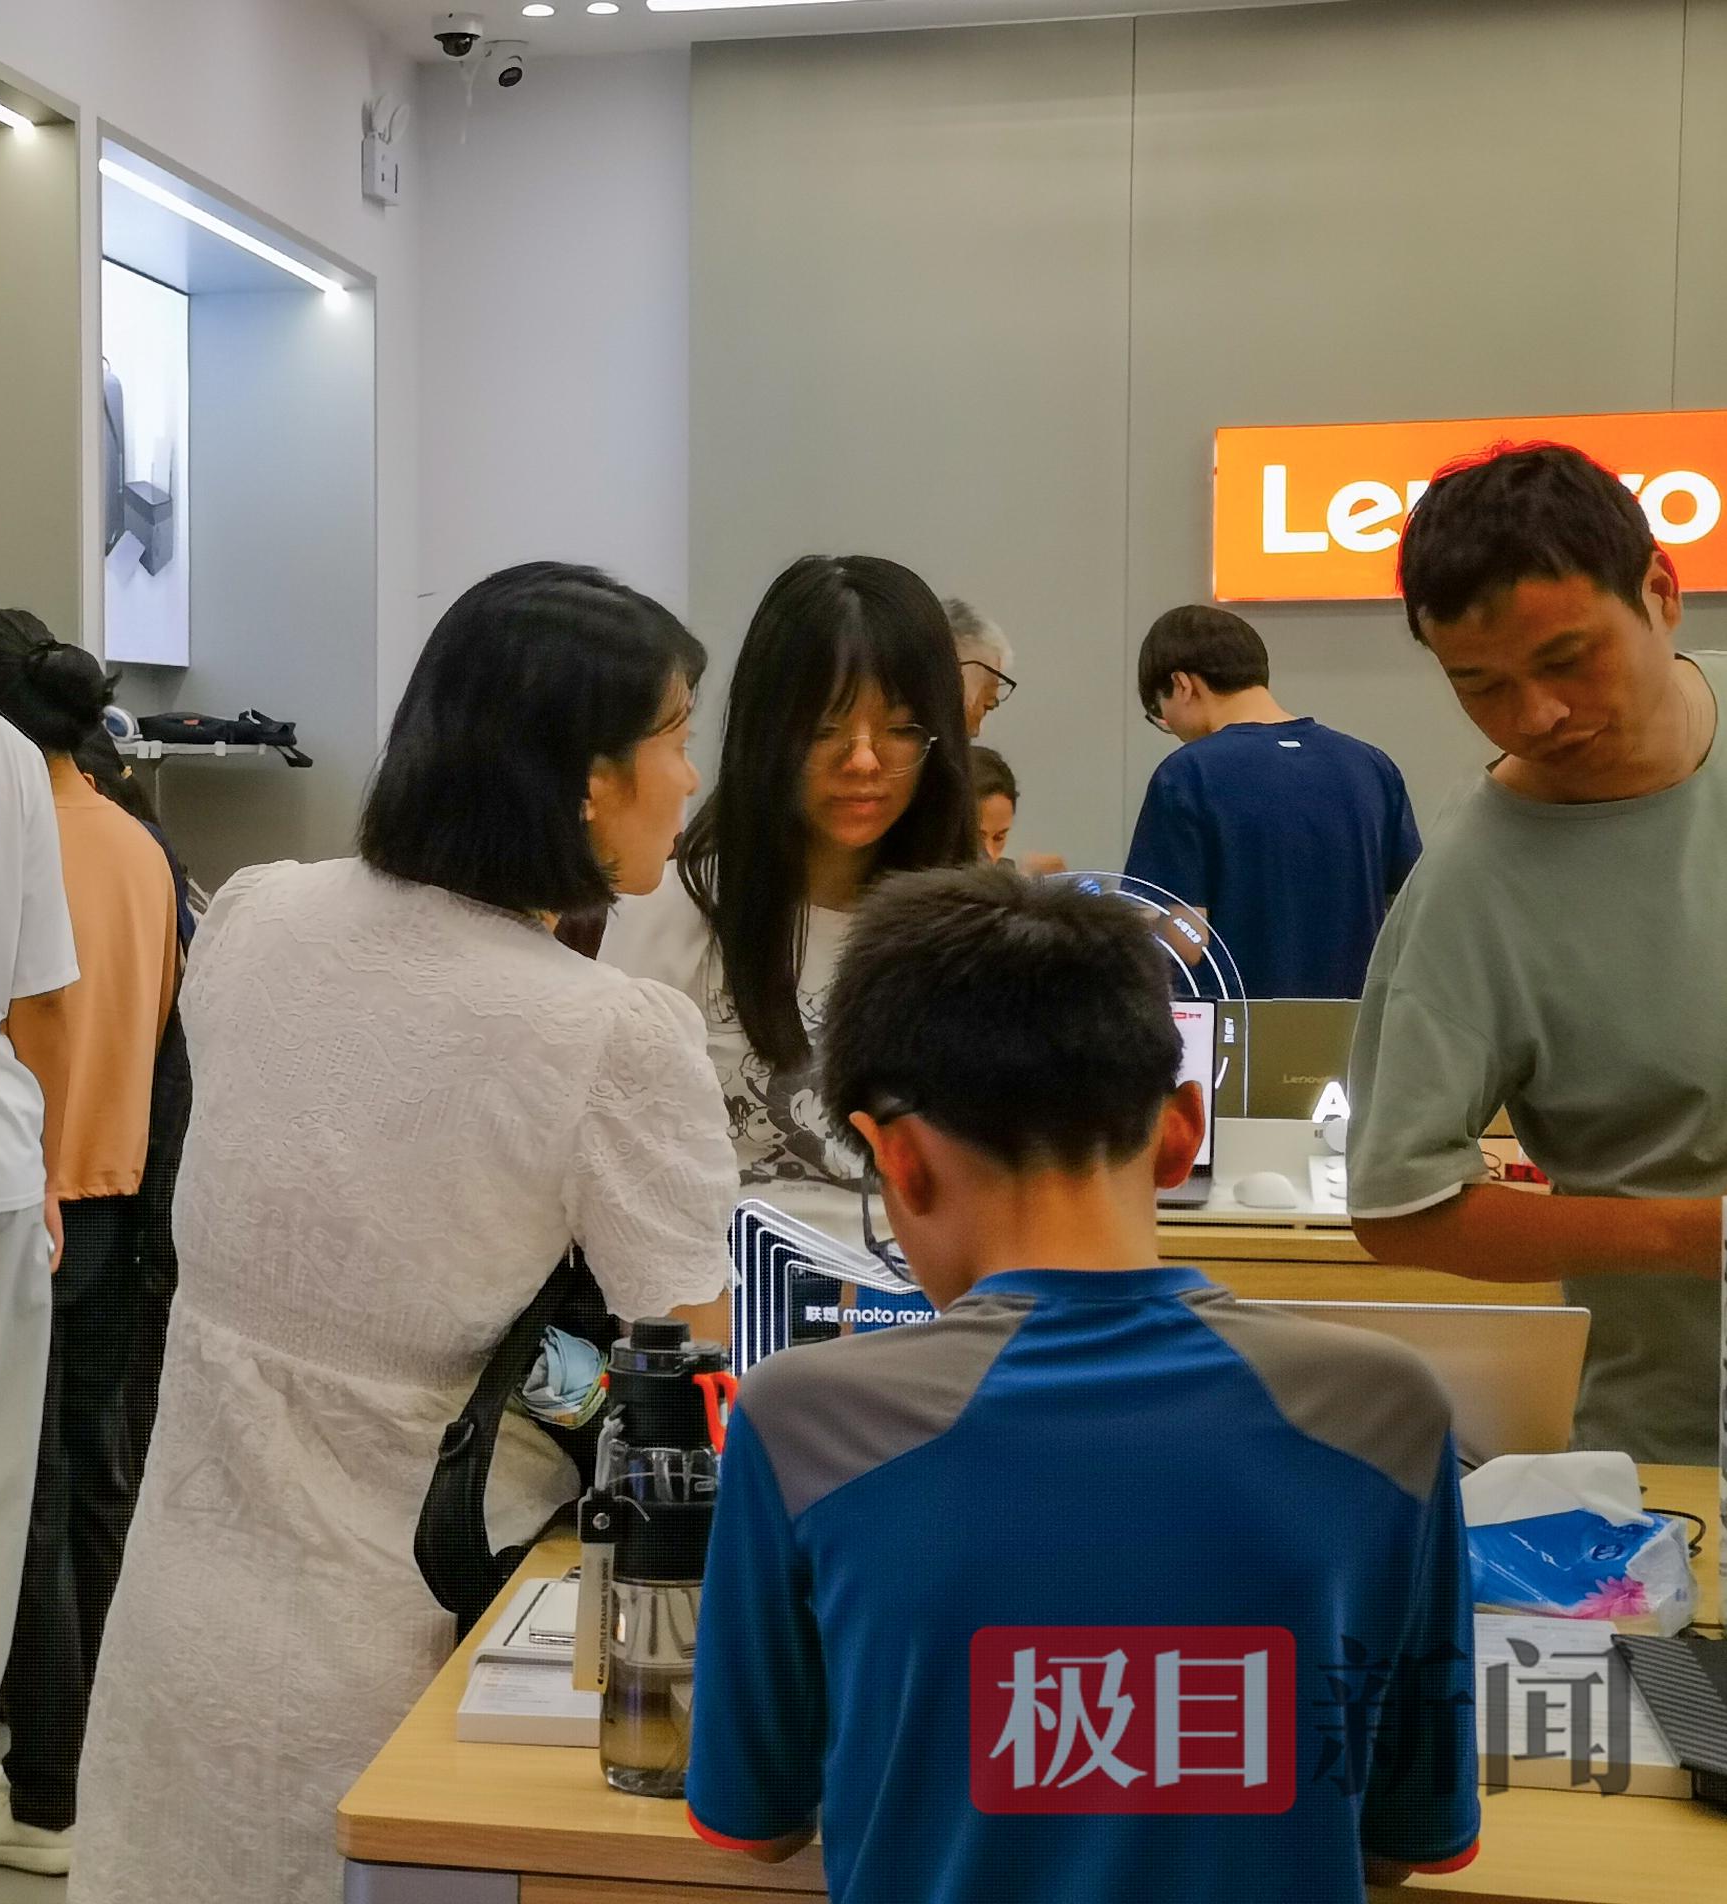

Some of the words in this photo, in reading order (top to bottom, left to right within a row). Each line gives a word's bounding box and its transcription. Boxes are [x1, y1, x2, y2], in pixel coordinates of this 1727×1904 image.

[1263, 464, 1722, 554] Leo
[804, 1306, 839, 1323] 联想
[842, 1306, 895, 1324] moto
[896, 1309, 933, 1324] razr
